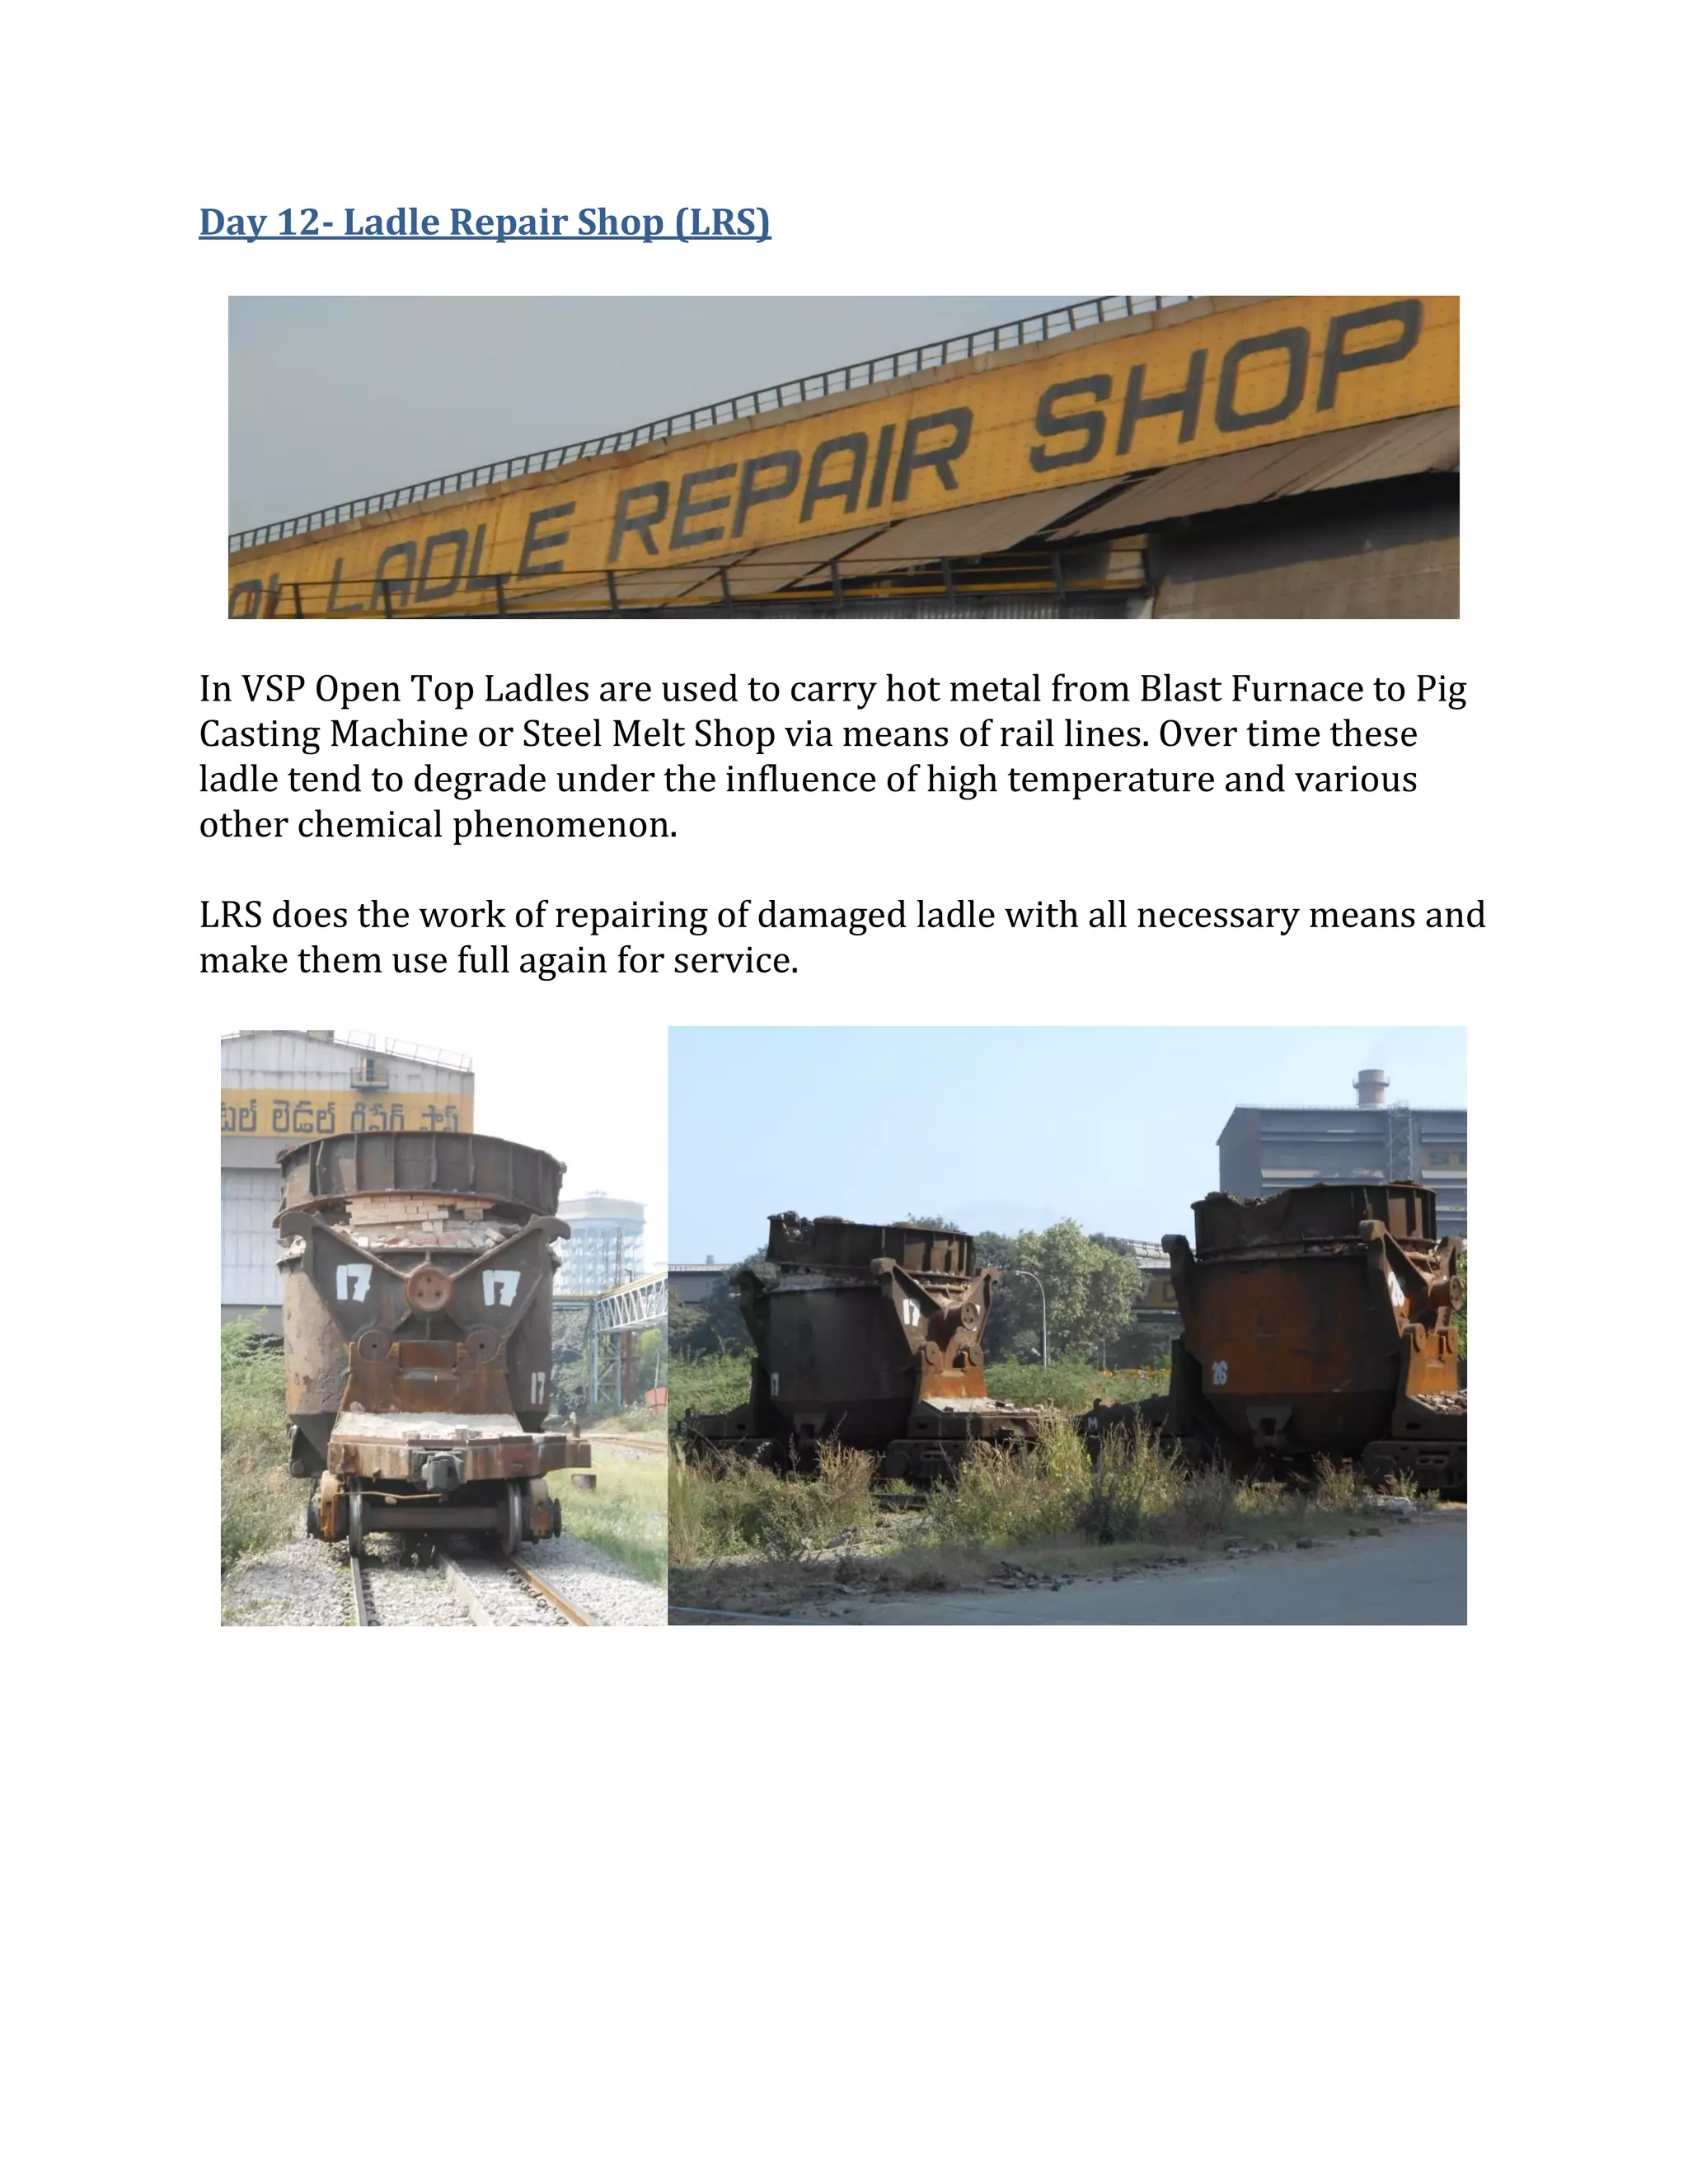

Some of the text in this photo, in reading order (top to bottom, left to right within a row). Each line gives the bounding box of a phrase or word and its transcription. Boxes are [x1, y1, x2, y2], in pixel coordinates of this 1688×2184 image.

[200, 208, 769, 243] Day 12- Ladle Repair Shop (LRS)
[327, 501, 576, 614] LADLE
[606, 405, 974, 564] REPAIR
[1029, 299, 1423, 472] SHOP
[201, 673, 1466, 710] In VSP Open Top Ladles are used to carry hot metal from Blast Furnace to Pig
[201, 719, 1417, 753] Casting Machine or Steel Melt Shop via means of rail lines. Over time these
[200, 764, 1416, 800] ladle tend to degrade under the influence of high temperature and various
[200, 809, 676, 845] other chemical phenomenon.
[201, 900, 1485, 935] LRS does the work of repairing of damaged ladle with all necessary means and
[200, 945, 797, 981] make them use full again for service.
[336, 1264, 373, 1302] 17
[483, 1270, 521, 1306] 17
[903, 1298, 921, 1327] 17
[530, 1371, 546, 1405] 17
